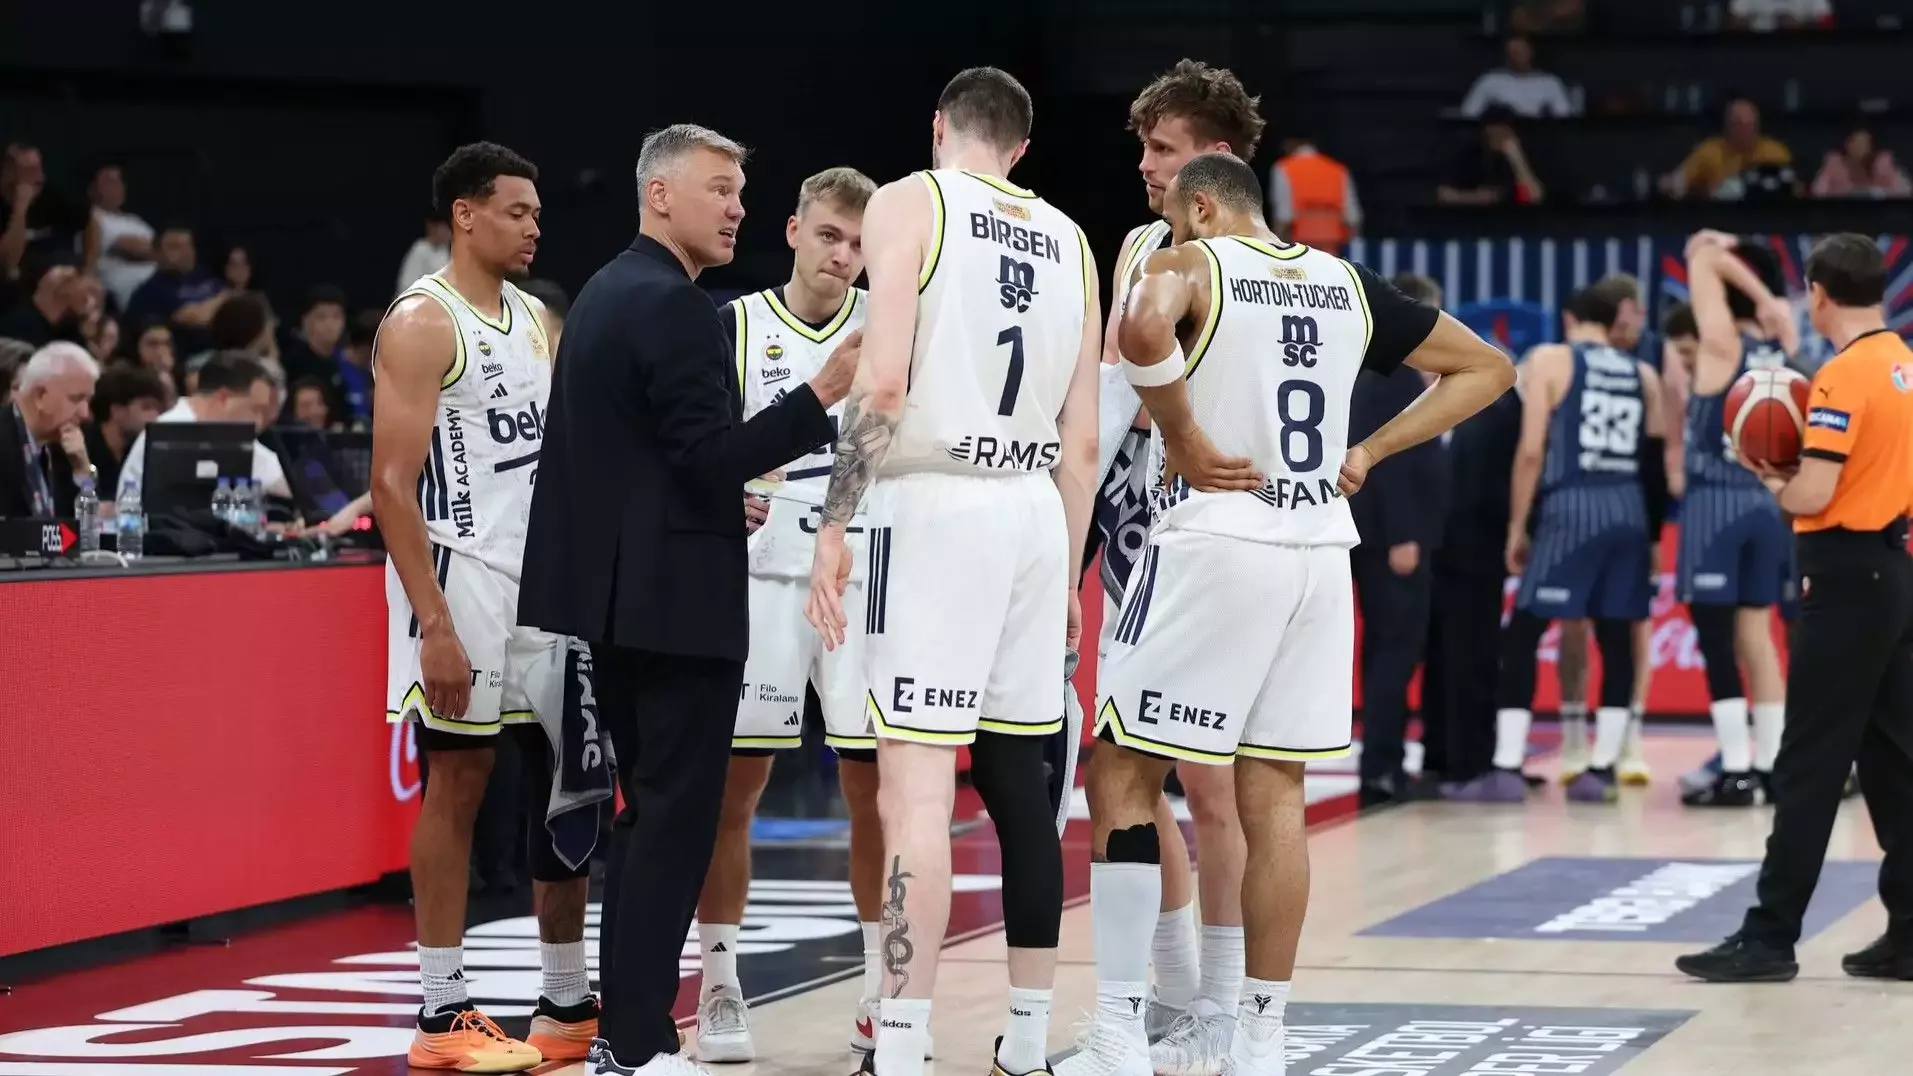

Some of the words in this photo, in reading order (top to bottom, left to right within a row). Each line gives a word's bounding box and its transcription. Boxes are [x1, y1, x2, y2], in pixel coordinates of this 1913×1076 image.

[970, 209, 1061, 264] BİRSEN
[1229, 277, 1352, 311] HORTON-TUCKER
[481, 362, 503, 374] beko
[761, 367, 791, 379] beko
[997, 325, 1024, 417] 1
[1277, 379, 1325, 473] 8
[446, 407, 470, 486] ACADEMY
[973, 436, 1060, 471] RAMS
[451, 490, 475, 539] Milk
[760, 684, 777, 692] Filo
[760, 693, 799, 703] Kiralama
[924, 687, 978, 708] ENEZ
[1169, 703, 1227, 731] ENEZ
